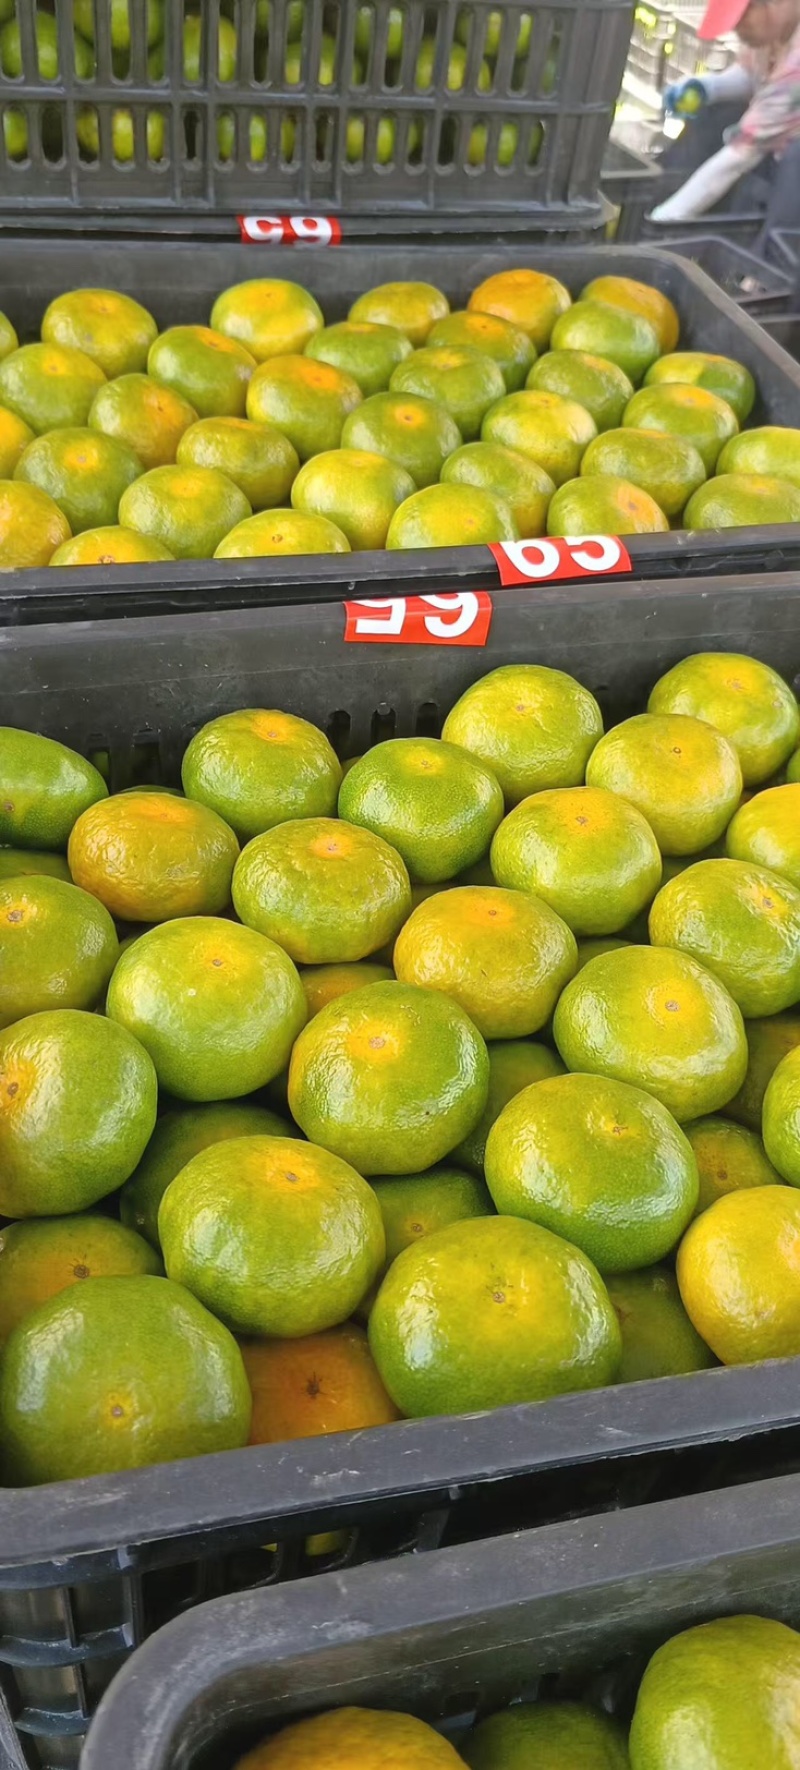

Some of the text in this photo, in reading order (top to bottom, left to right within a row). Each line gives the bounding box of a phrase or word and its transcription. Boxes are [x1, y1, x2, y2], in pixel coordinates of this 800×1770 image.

[243, 216, 332, 245] 65
[499, 535, 620, 578] 65
[352, 592, 478, 638] 65
